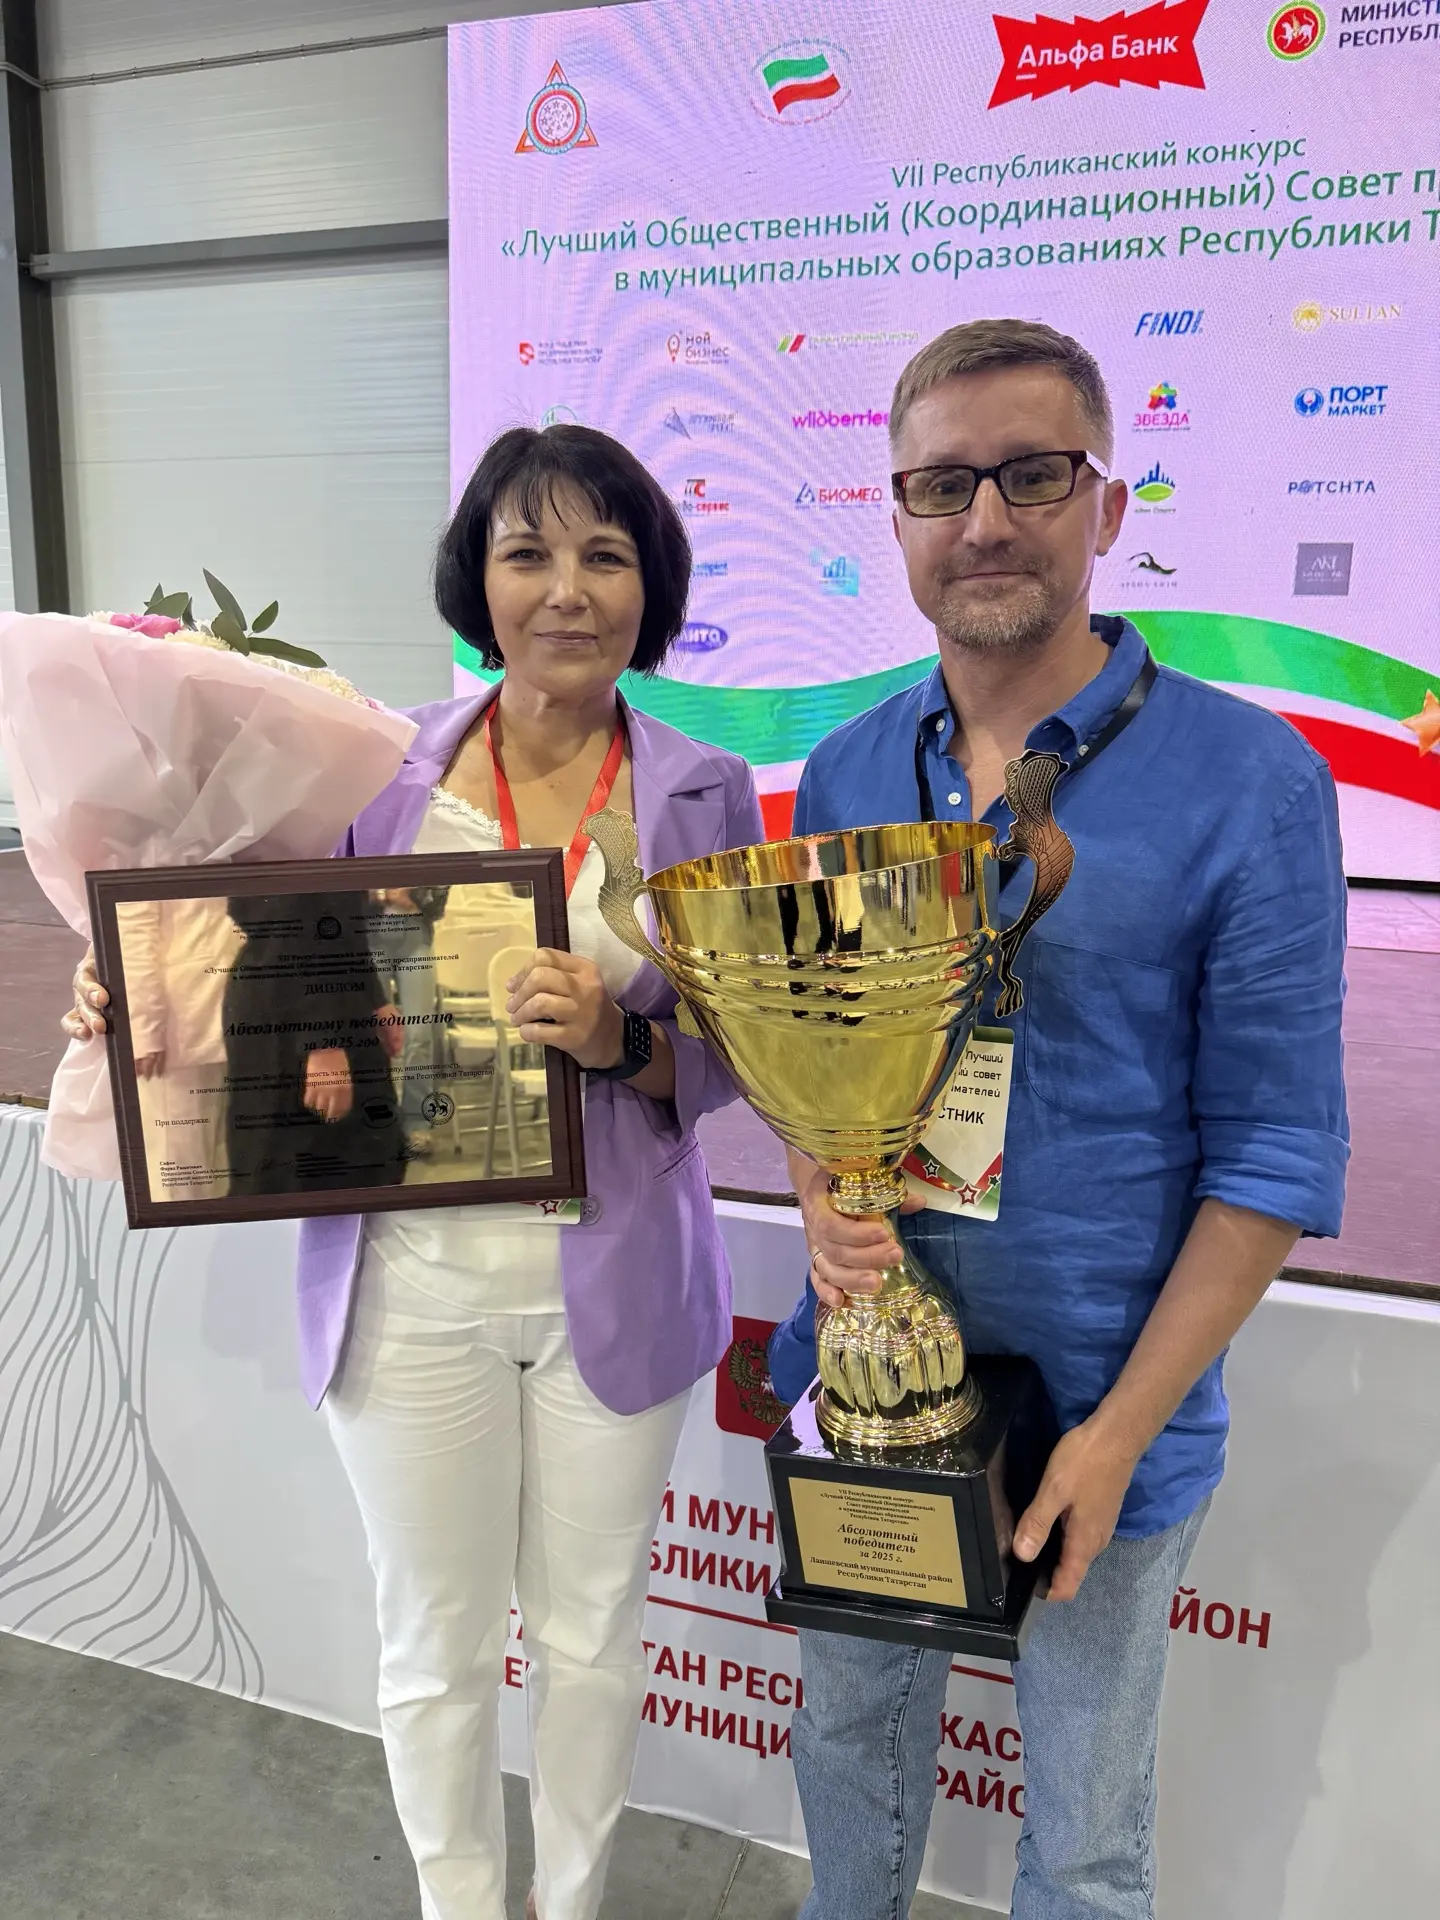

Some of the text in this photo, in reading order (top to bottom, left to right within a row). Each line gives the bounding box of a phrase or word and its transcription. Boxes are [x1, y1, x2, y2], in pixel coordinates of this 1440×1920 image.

[1016, 34, 1180, 72] Альфа Банк
[891, 137, 1307, 188] VII Республиканский конкурс
[501, 168, 1440, 265] «Лучший Общественный (Координационный) Совет п
[615, 270, 629, 291] в
[639, 251, 902, 297] муниципальных
[911, 235, 1167, 280] образованиях
[1178, 215, 1412, 261] Республики
[1328, 385, 1389, 403] ПОРТ
[1327, 404, 1387, 417] МАРКЕТ
[1133, 412, 1190, 430] ЗВЕЗДА
[393, 953, 460, 964] предпринимателей
[304, 981, 366, 996] ДИПЛОМ
[224, 1011, 454, 1038] Абсолютному победителю
[321, 1034, 353, 1050] 2025
[965, 1050, 1004, 1064] Лучший
[973, 1070, 1002, 1081] совет
[155, 1119, 171, 1128] При
[688, 1494, 775, 1545] МУН
[837, 1523, 919, 1543] Абсолютный
[843, 1536, 917, 1554] победитель
[859, 1550, 869, 1559] за
[872, 1550, 894, 1562] 2025
[809, 1556, 953, 1584] Лаишевский муниципальный район
[837, 1569, 927, 1589] Республики Татарстан
[1169, 1585, 1272, 1650] ЙОН
[719, 1658, 804, 1710] РЕС
